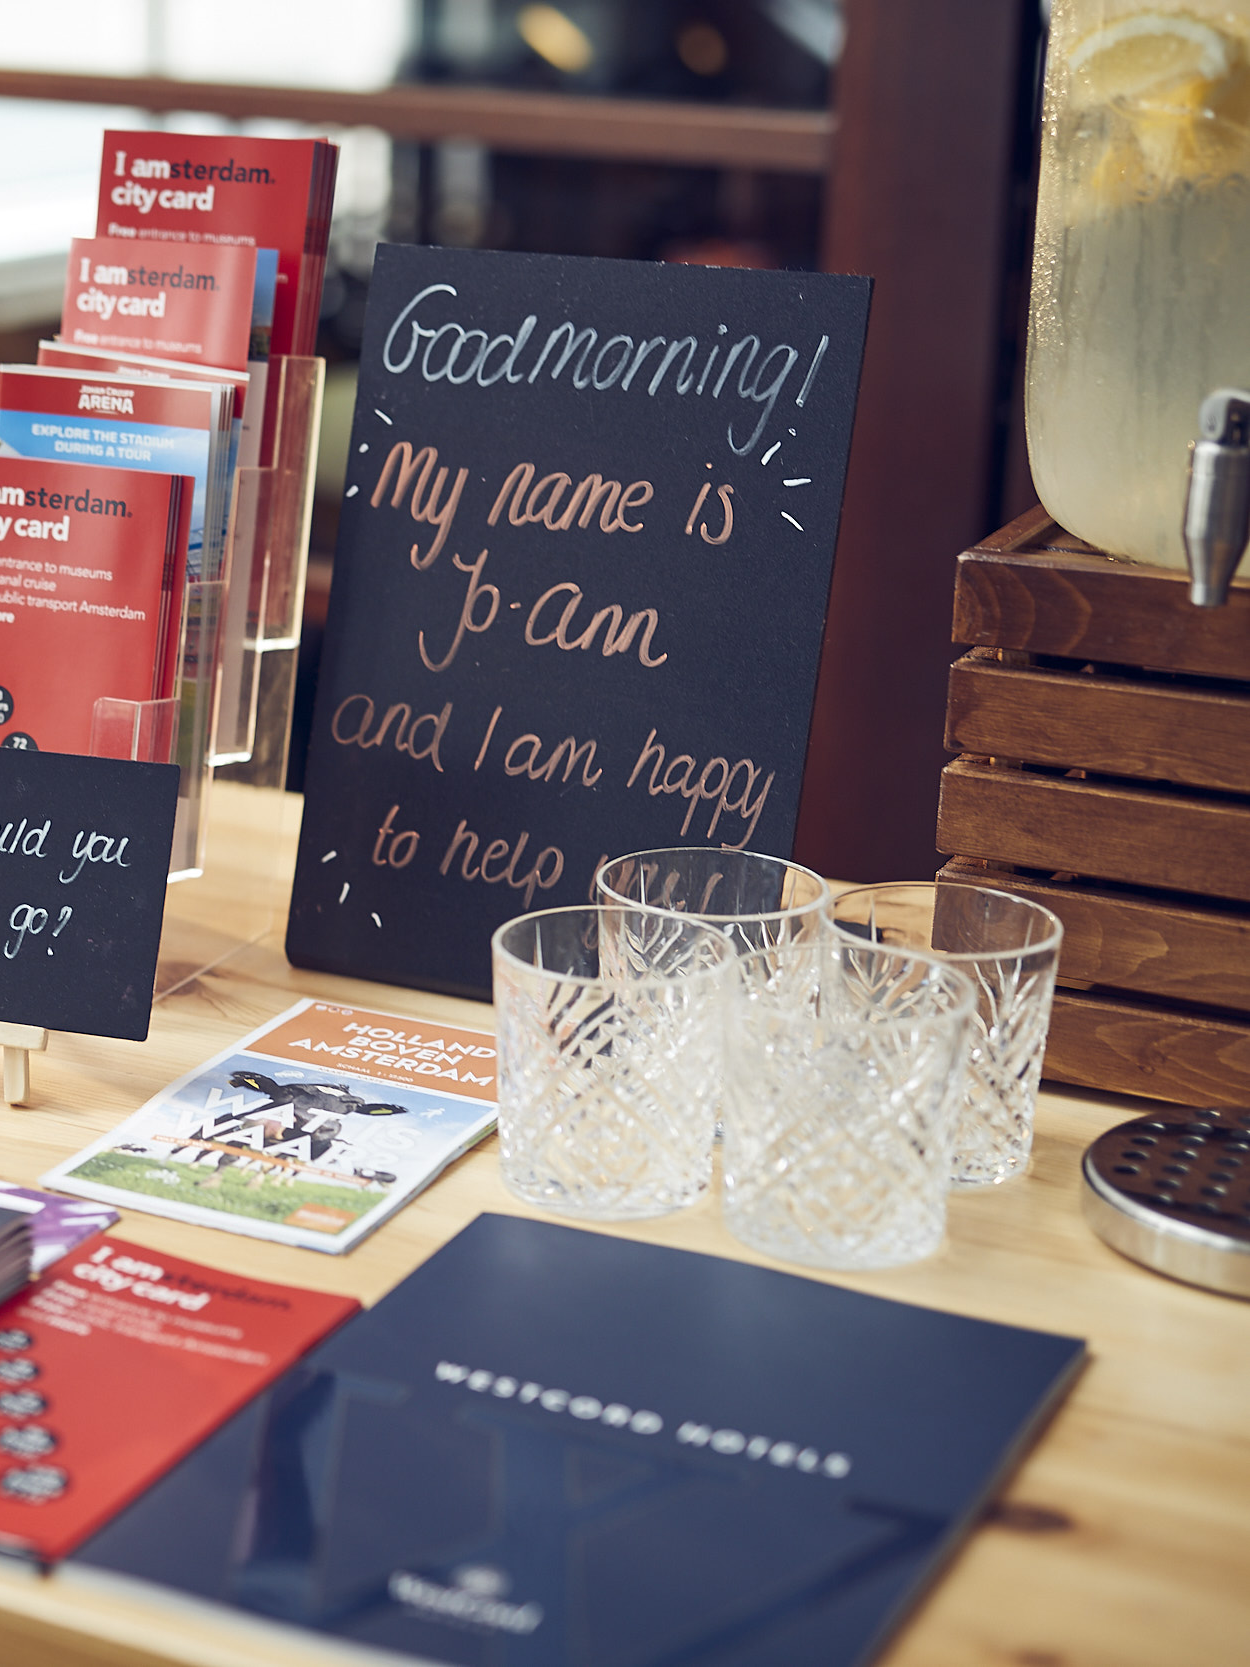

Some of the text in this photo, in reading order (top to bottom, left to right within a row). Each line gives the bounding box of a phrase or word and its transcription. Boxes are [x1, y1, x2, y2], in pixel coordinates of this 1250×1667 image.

[114, 151, 127, 177] I
[111, 180, 215, 214] city card
[108, 222, 137, 239] Free
[188, 230, 201, 243] to
[203, 231, 256, 248] museums
[79, 257, 91, 283] I
[76, 287, 166, 320] city card
[73, 328, 99, 345] Free
[78, 394, 135, 415] ARENA
[31, 423, 175, 449] EXPLORE THE STADIUM
[54, 440, 152, 462] DURING A TOUR
[371, 442, 734, 570] My name is
[14, 515, 70, 542] card
[23, 577, 57, 592] cruise
[44, 561, 57, 574] to
[58, 565, 113, 581] museums
[26, 594, 78, 613] transport
[78, 600, 146, 621] Amsterdam
[12, 736, 28, 750] 72
[331, 694, 453, 773] and
[474, 705, 502, 772] I
[627, 727, 776, 850] happy
[58, 829, 132, 884] you
[372, 804, 420, 869] to
[438, 819, 565, 909] help
[3, 902, 74, 960] go?
[342, 1022, 497, 1059] HOLLAND
[348, 1035, 463, 1066] BOVEN
[288, 1038, 495, 1087] AMSTERDAM
[203, 1087, 347, 1134] WAT
